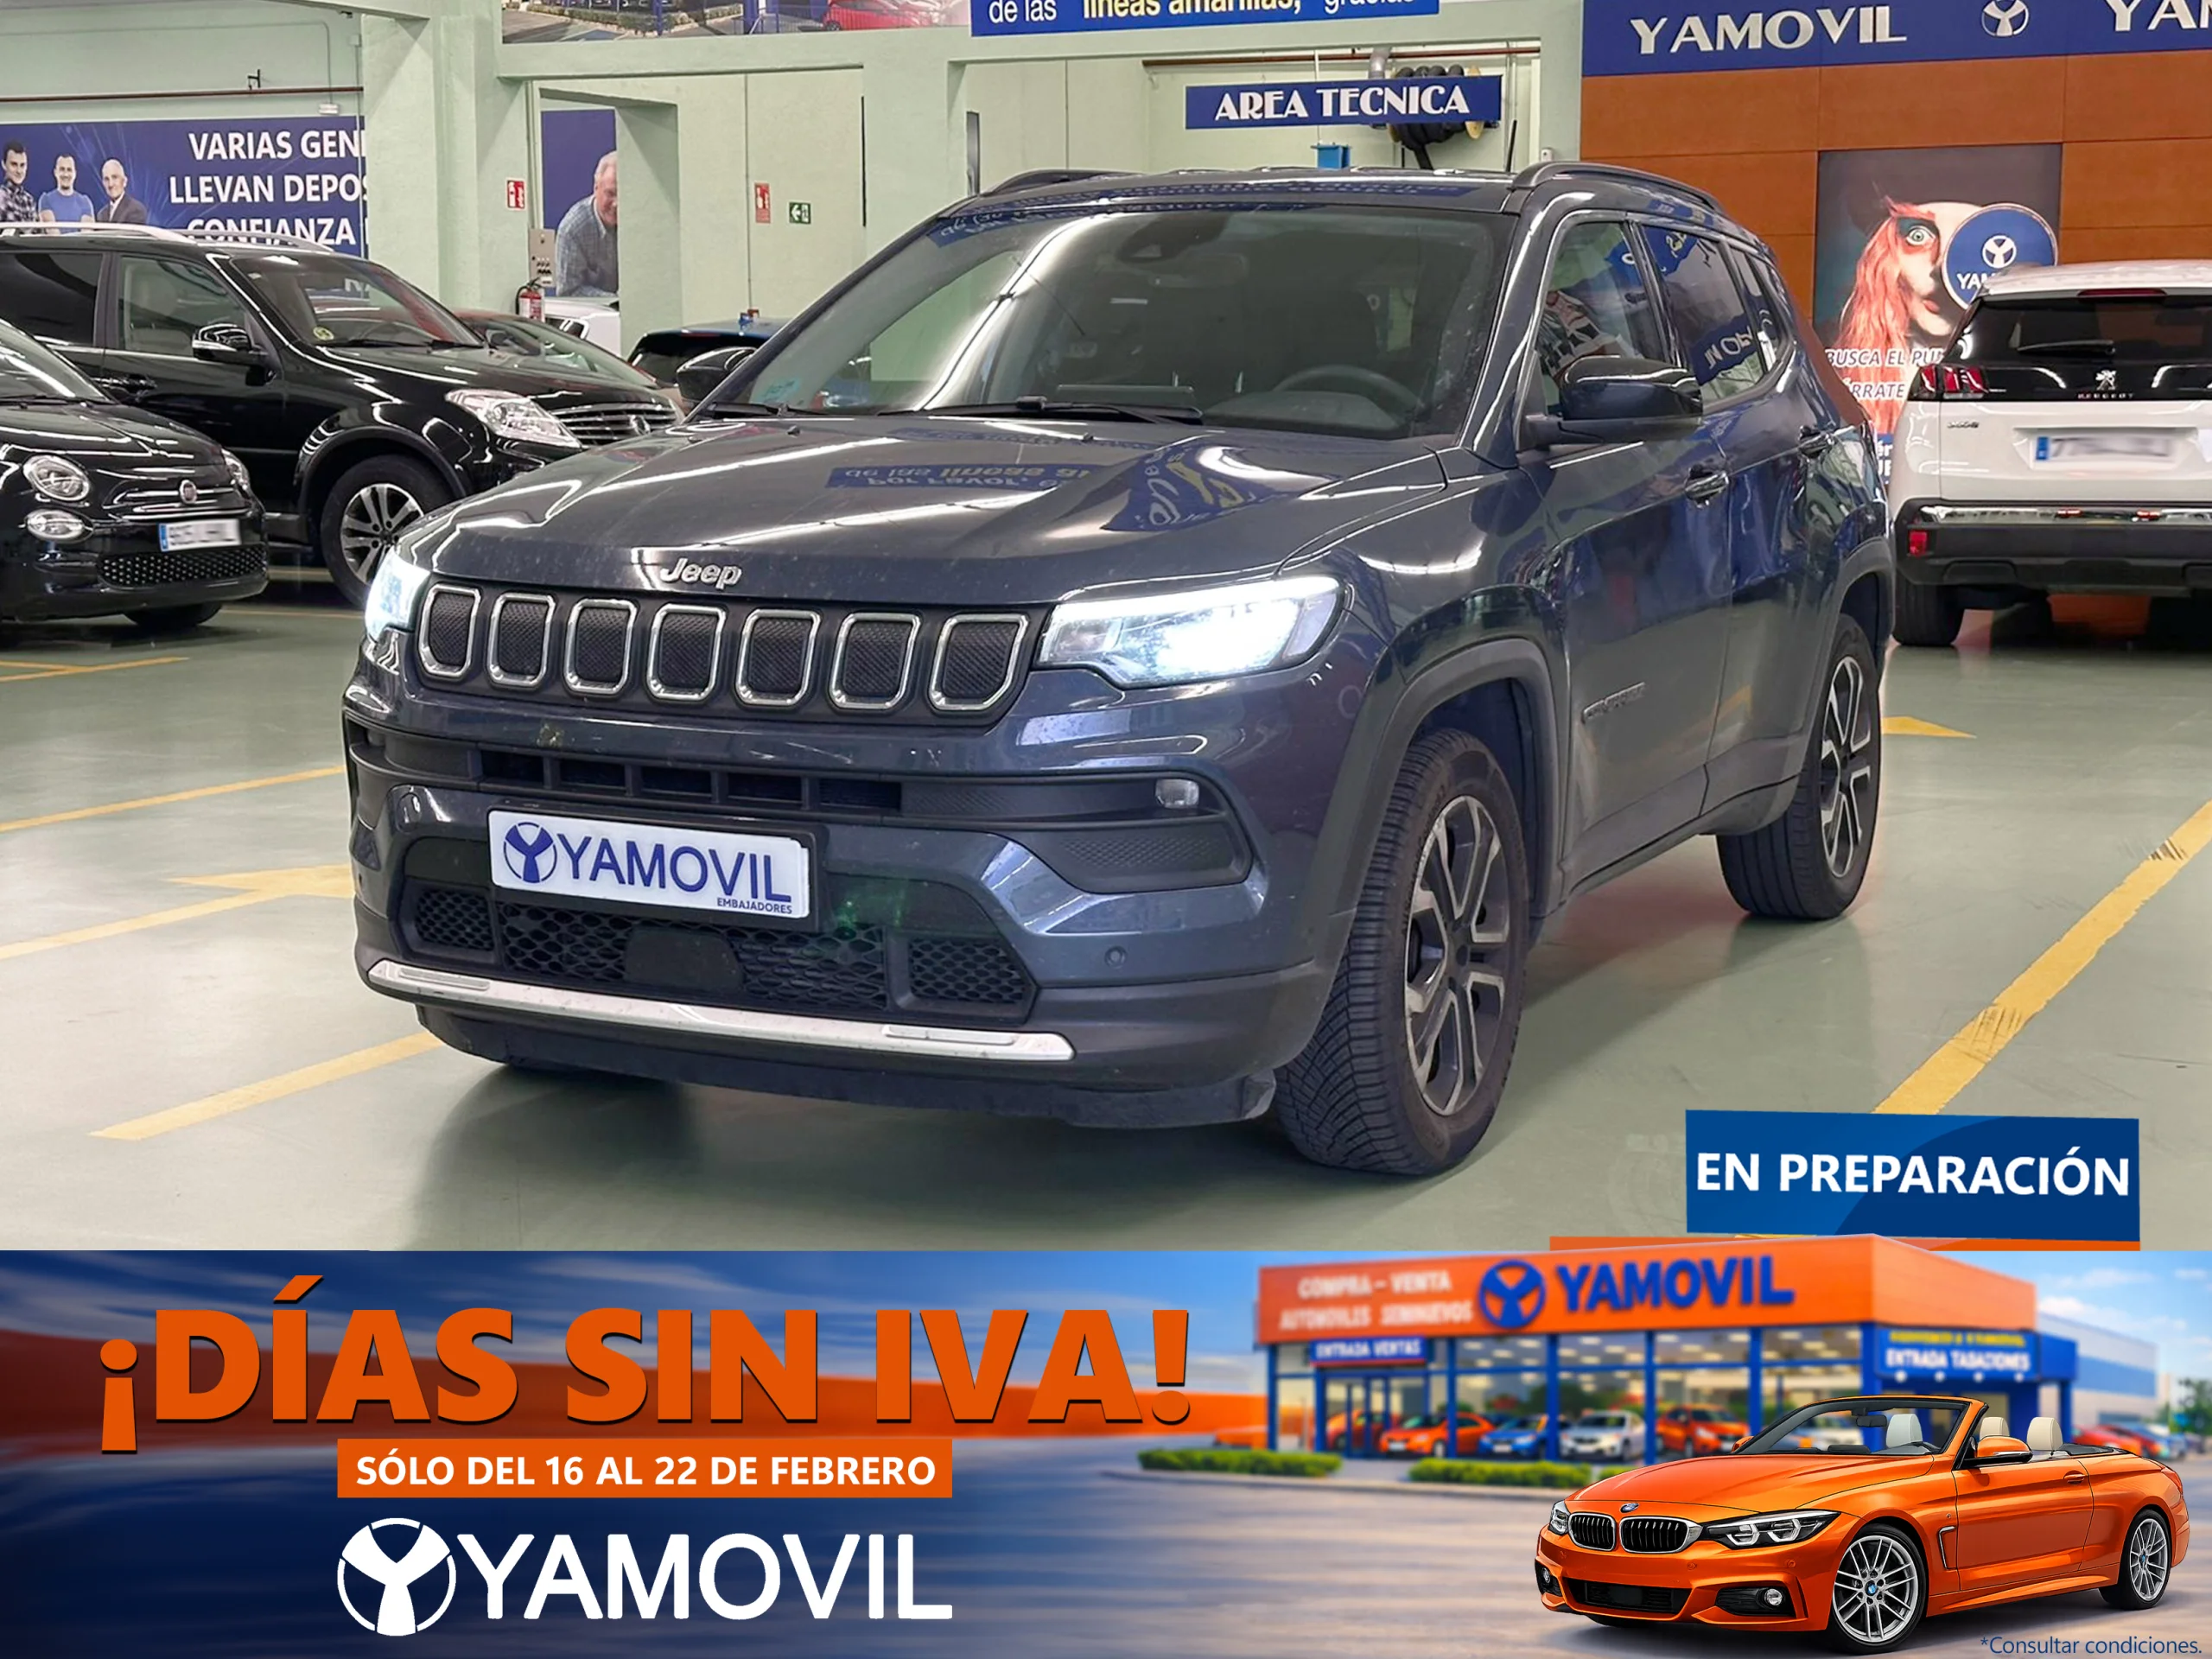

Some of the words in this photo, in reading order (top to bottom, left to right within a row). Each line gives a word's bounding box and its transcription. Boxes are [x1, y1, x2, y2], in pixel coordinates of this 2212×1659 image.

[988, 0, 1018, 22] de
[1025, 0, 1057, 22] las
[2103, 0, 2212, 32] YA
[1630, 5, 1907, 54] YAMOVIL
[1215, 92, 1308, 120] AREA
[1316, 86, 1470, 117] TECNICA
[188, 130, 292, 160] VARIAS
[169, 175, 274, 203] LLEVAN
[283, 173, 368, 201] DEPO
[1888, 350, 1905, 365] EL
[1844, 379, 1905, 398] RRATE
[660, 557, 742, 590] Jeep
[557, 833, 791, 903] YAMOVIL
[716, 897, 792, 915] EMBAJADORES
